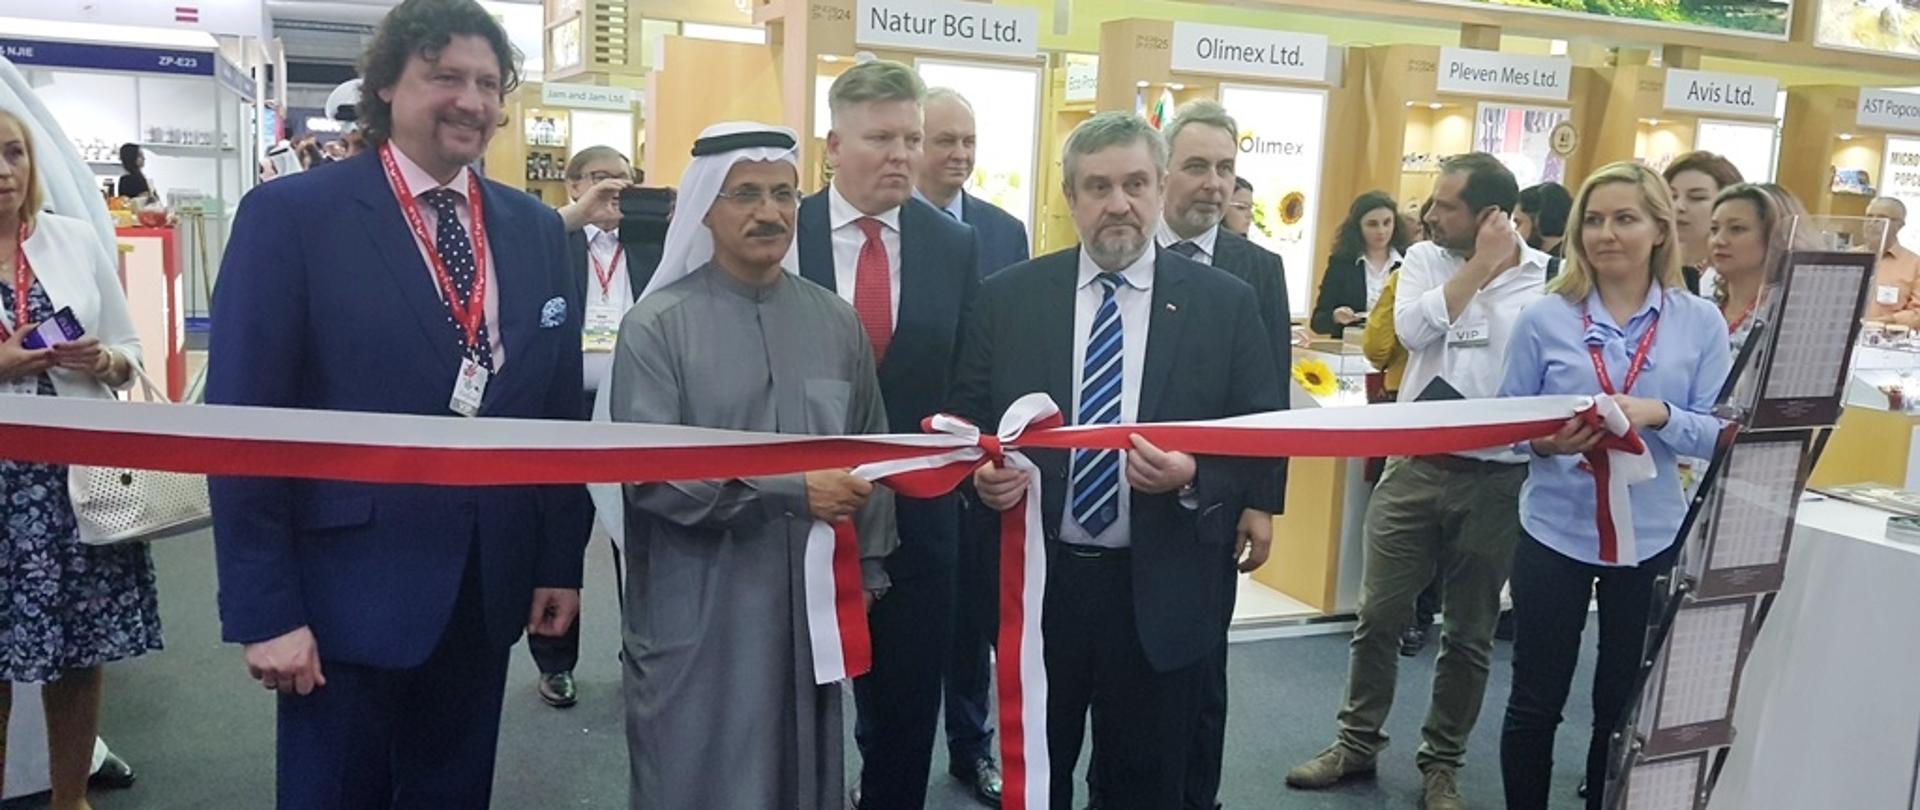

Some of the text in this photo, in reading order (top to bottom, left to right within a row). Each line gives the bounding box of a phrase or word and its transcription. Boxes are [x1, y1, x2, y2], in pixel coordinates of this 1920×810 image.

[870, 7, 1023, 43] Natur BG Ltd.
[7, 46, 33, 57] NJIE
[1196, 37, 1305, 66] Olimex Ltd.
[158, 55, 198, 68] ZP-E23
[1450, 61, 1498, 82] Pleven
[1501, 66, 1530, 86] Mes
[1532, 69, 1559, 88] Ltd.
[547, 89, 625, 103] Jam and Jam Ltd.
[1687, 79, 1721, 103] Avis
[1725, 83, 1755, 107] Ltd.
[1863, 98, 1885, 114] AST
[1240, 136, 1303, 155] Olimex
[1456, 330, 1479, 340] VIP
